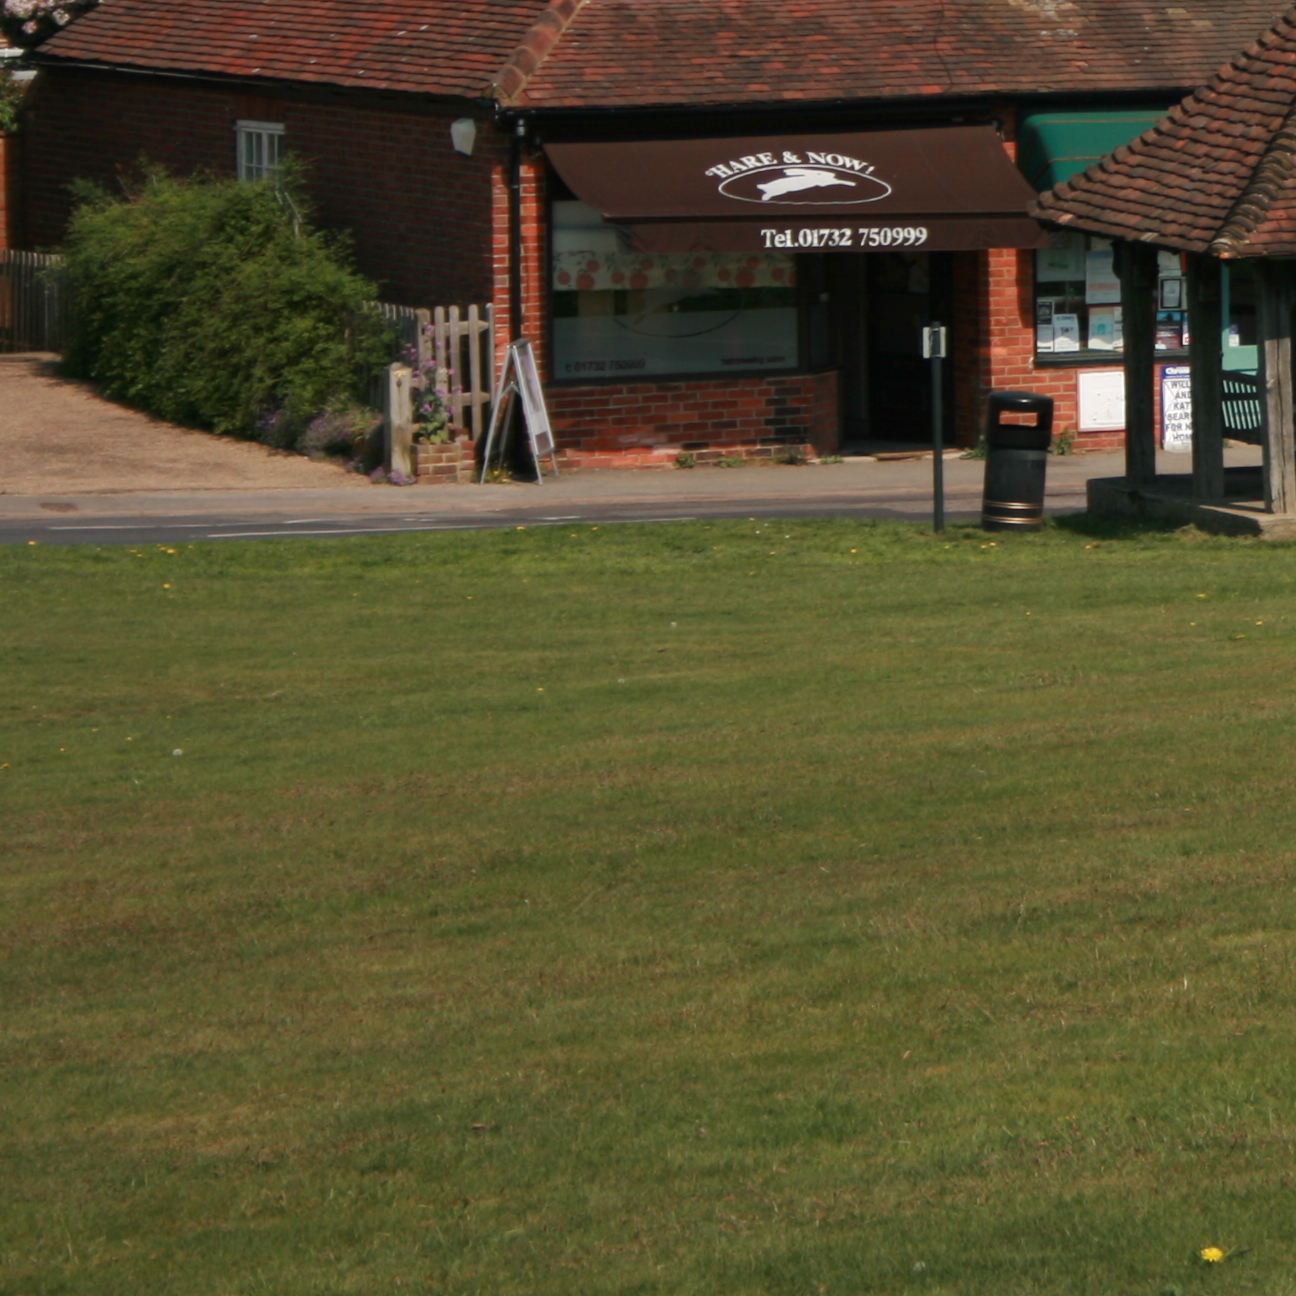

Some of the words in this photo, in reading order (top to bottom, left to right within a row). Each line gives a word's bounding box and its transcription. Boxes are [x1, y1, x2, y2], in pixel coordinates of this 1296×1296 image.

[782, 151, 801, 164] &
[858, 227, 928, 247] 750999
[574, 361, 605, 372] 01732
[1171, 380, 1191, 389] WILL
[1173, 402, 1191, 410] KAT
[1167, 412, 1191, 421] SEAR
[1165, 423, 1183, 432] FOR
[1173, 434, 1192, 442] HOM
